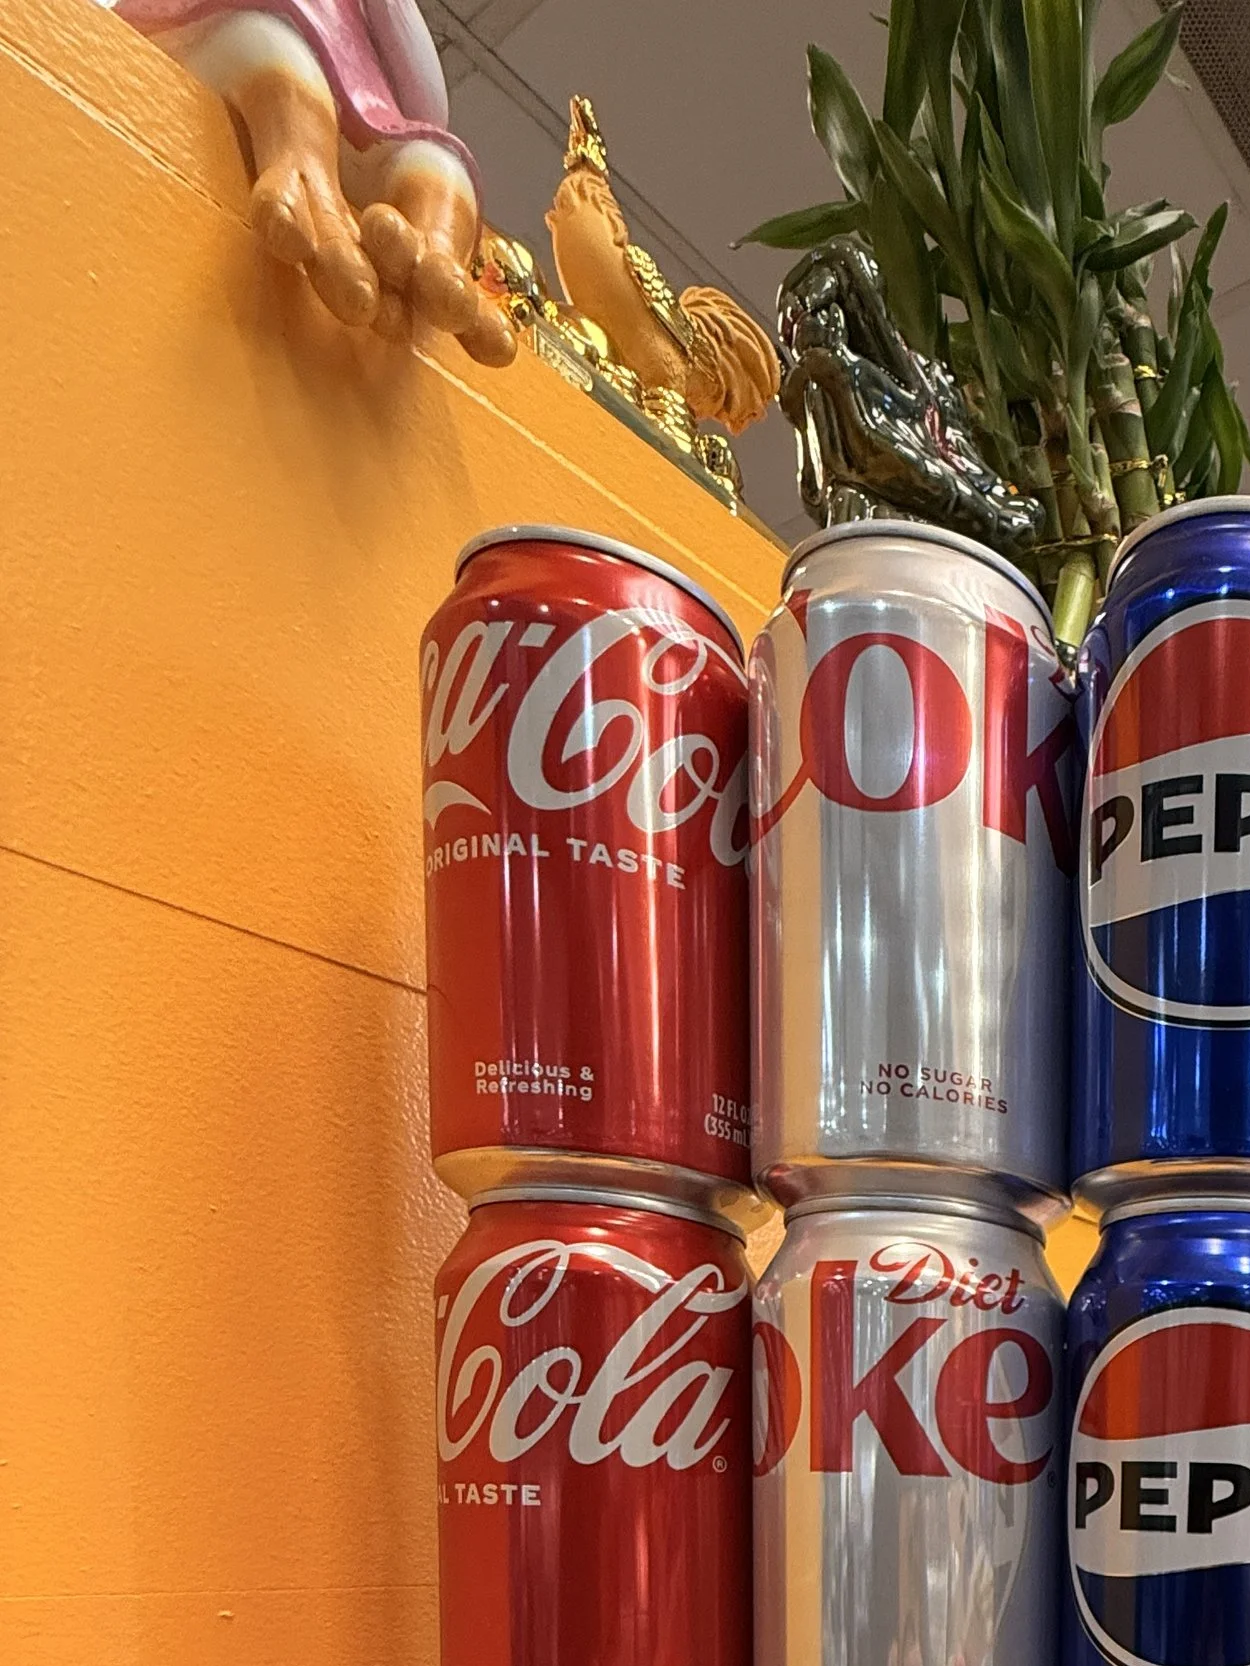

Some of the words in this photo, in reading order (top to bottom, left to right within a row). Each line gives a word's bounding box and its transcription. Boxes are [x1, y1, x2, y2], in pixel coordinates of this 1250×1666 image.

[426, 833, 550, 878] ORIGINAL
[566, 837, 687, 889] TASTE
[475, 1059, 572, 1081] Delicious
[579, 1064, 595, 1082] &
[878, 1062, 909, 1080] NO
[919, 1065, 993, 1093] SUGAR
[475, 1077, 595, 1102] Refreshing
[860, 1079, 892, 1097] NO
[901, 1083, 1009, 1115] CALORIES
[712, 1093, 725, 1116] 12
[727, 1099, 738, 1121] FL
[704, 1112, 731, 1141] (355
[870, 1241, 1024, 1314] Diet
[753, 1259, 1054, 1486] oke
[454, 1483, 542, 1507] TASTE
